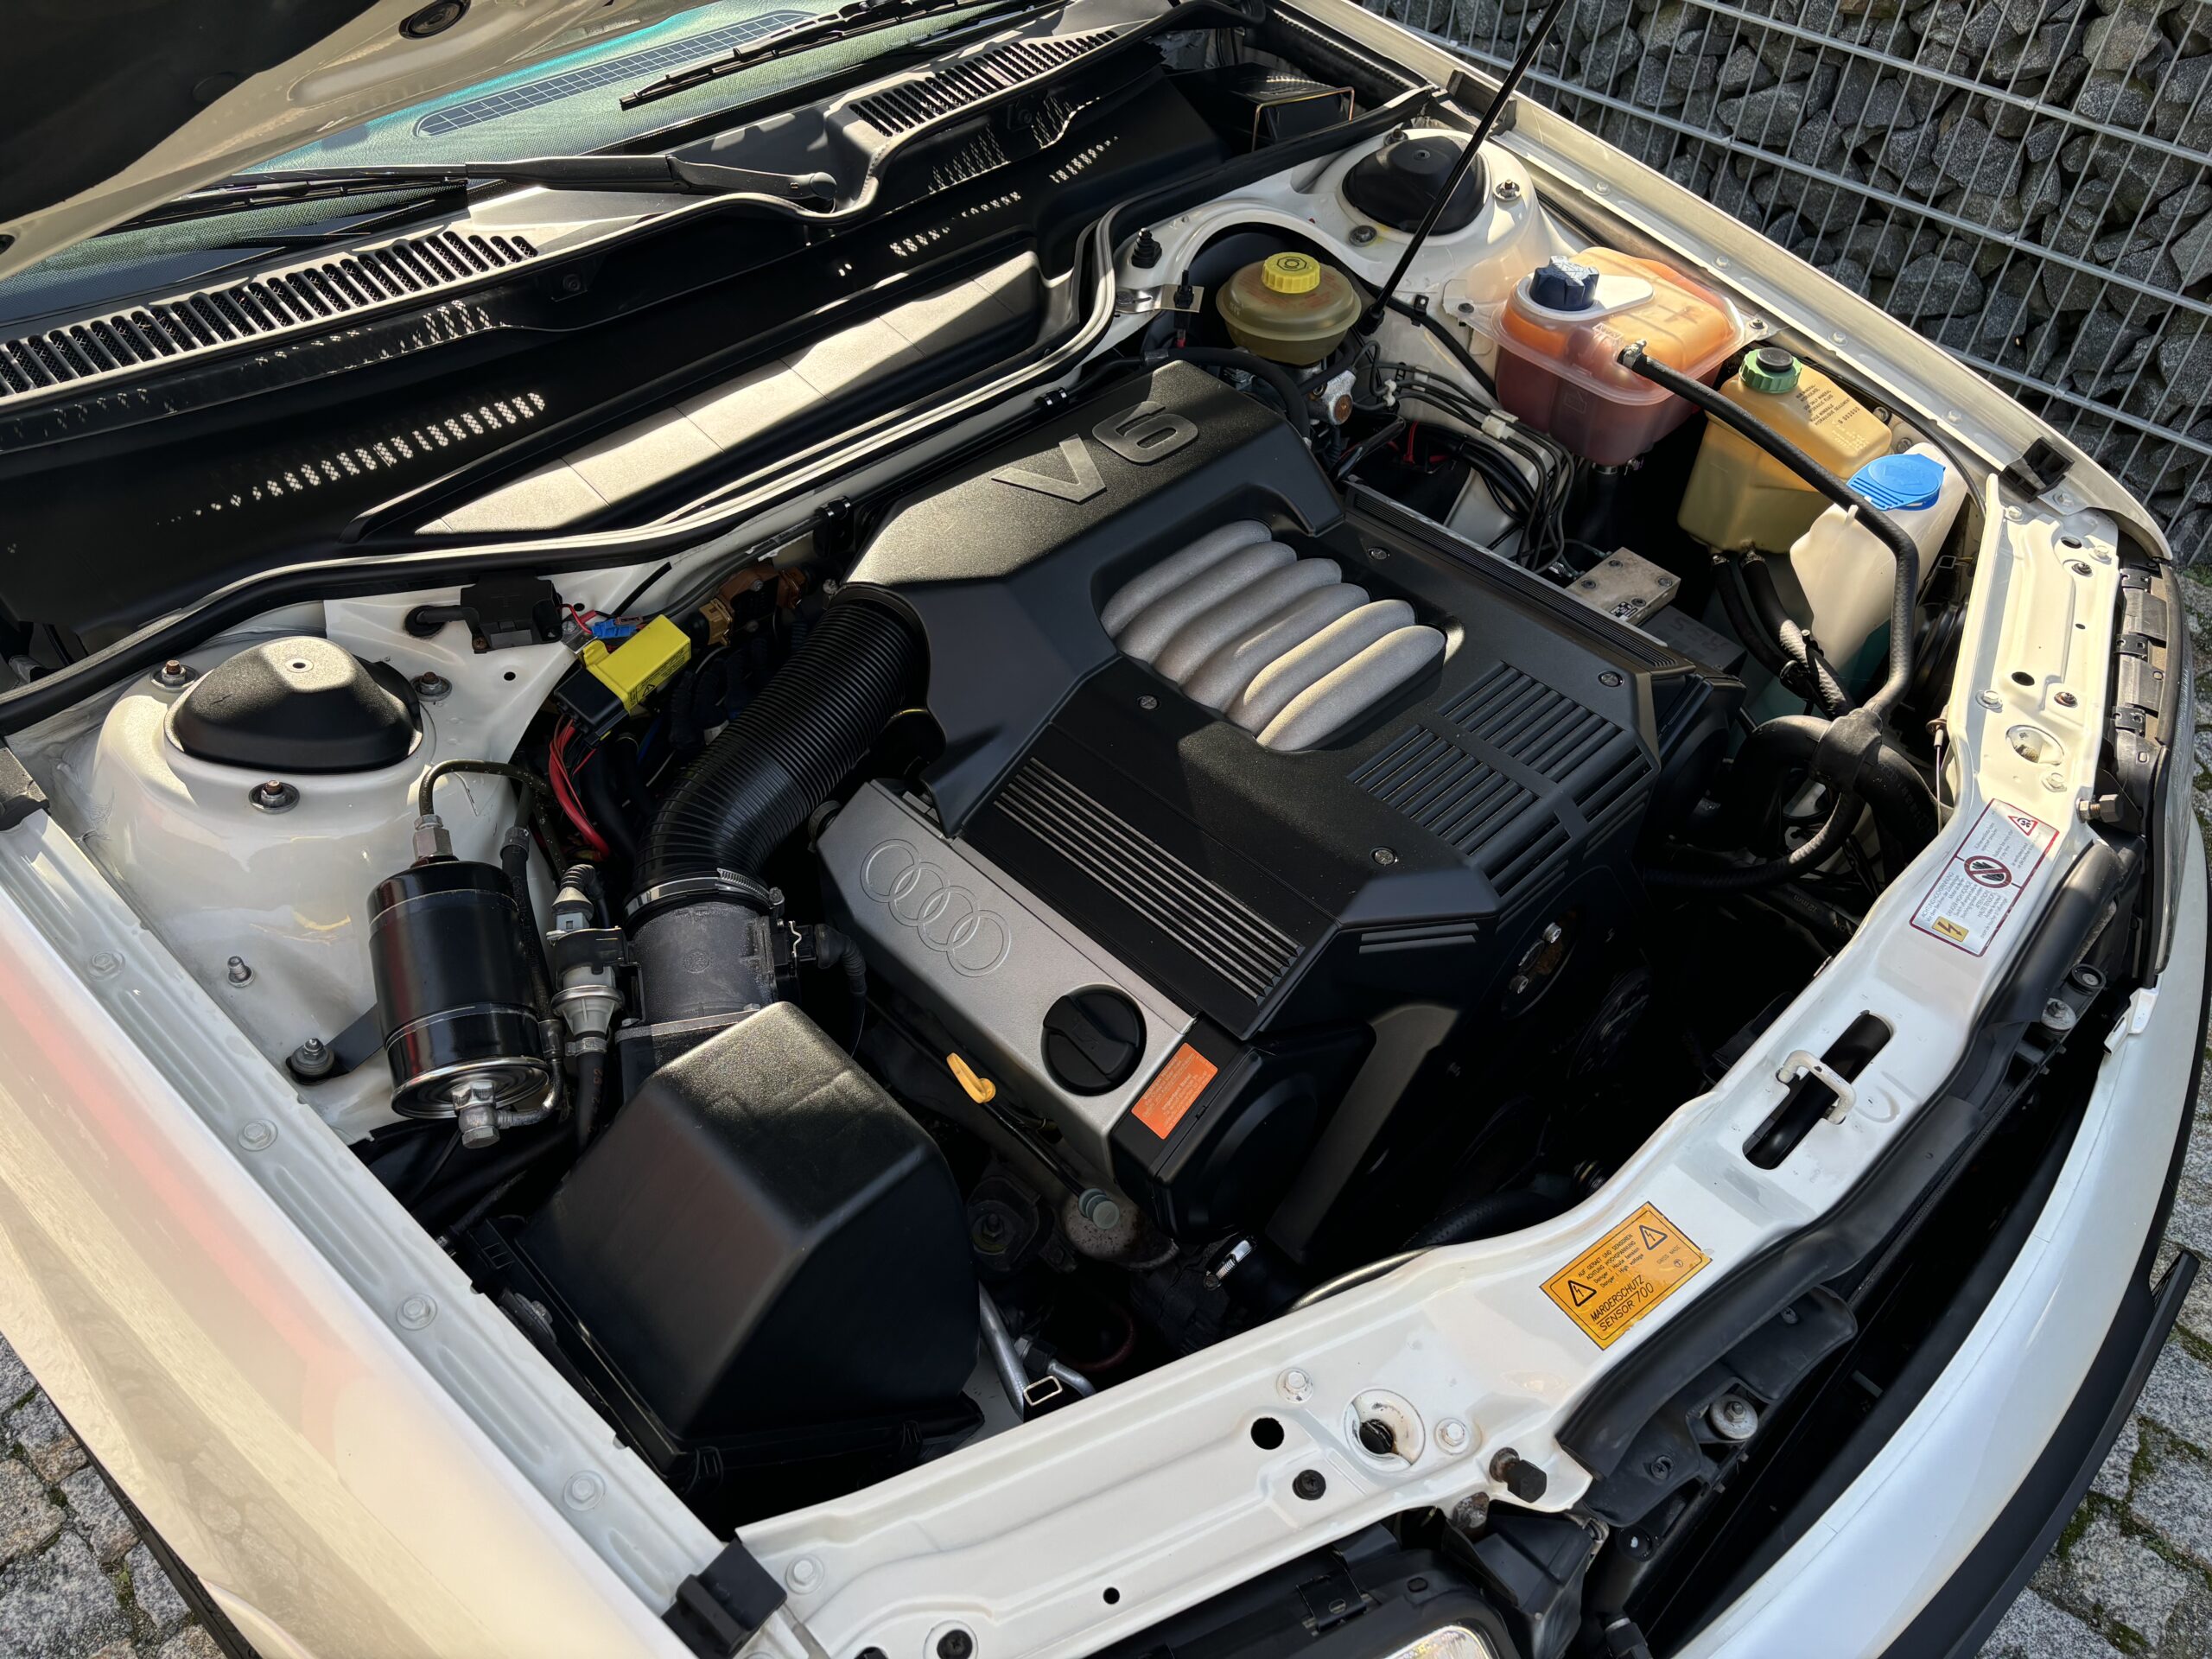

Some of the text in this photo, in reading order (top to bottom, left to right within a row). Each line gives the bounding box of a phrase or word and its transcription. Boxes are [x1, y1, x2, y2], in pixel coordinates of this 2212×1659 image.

[991, 401, 1199, 505] V6
[1586, 1264, 1605, 1281] ACHTUNG
[1602, 1249, 1613, 1259] UND
[1590, 1274, 1644, 1322] MARDERSCHUTZ
[1599, 1282, 1654, 1332] SENSOR 700
